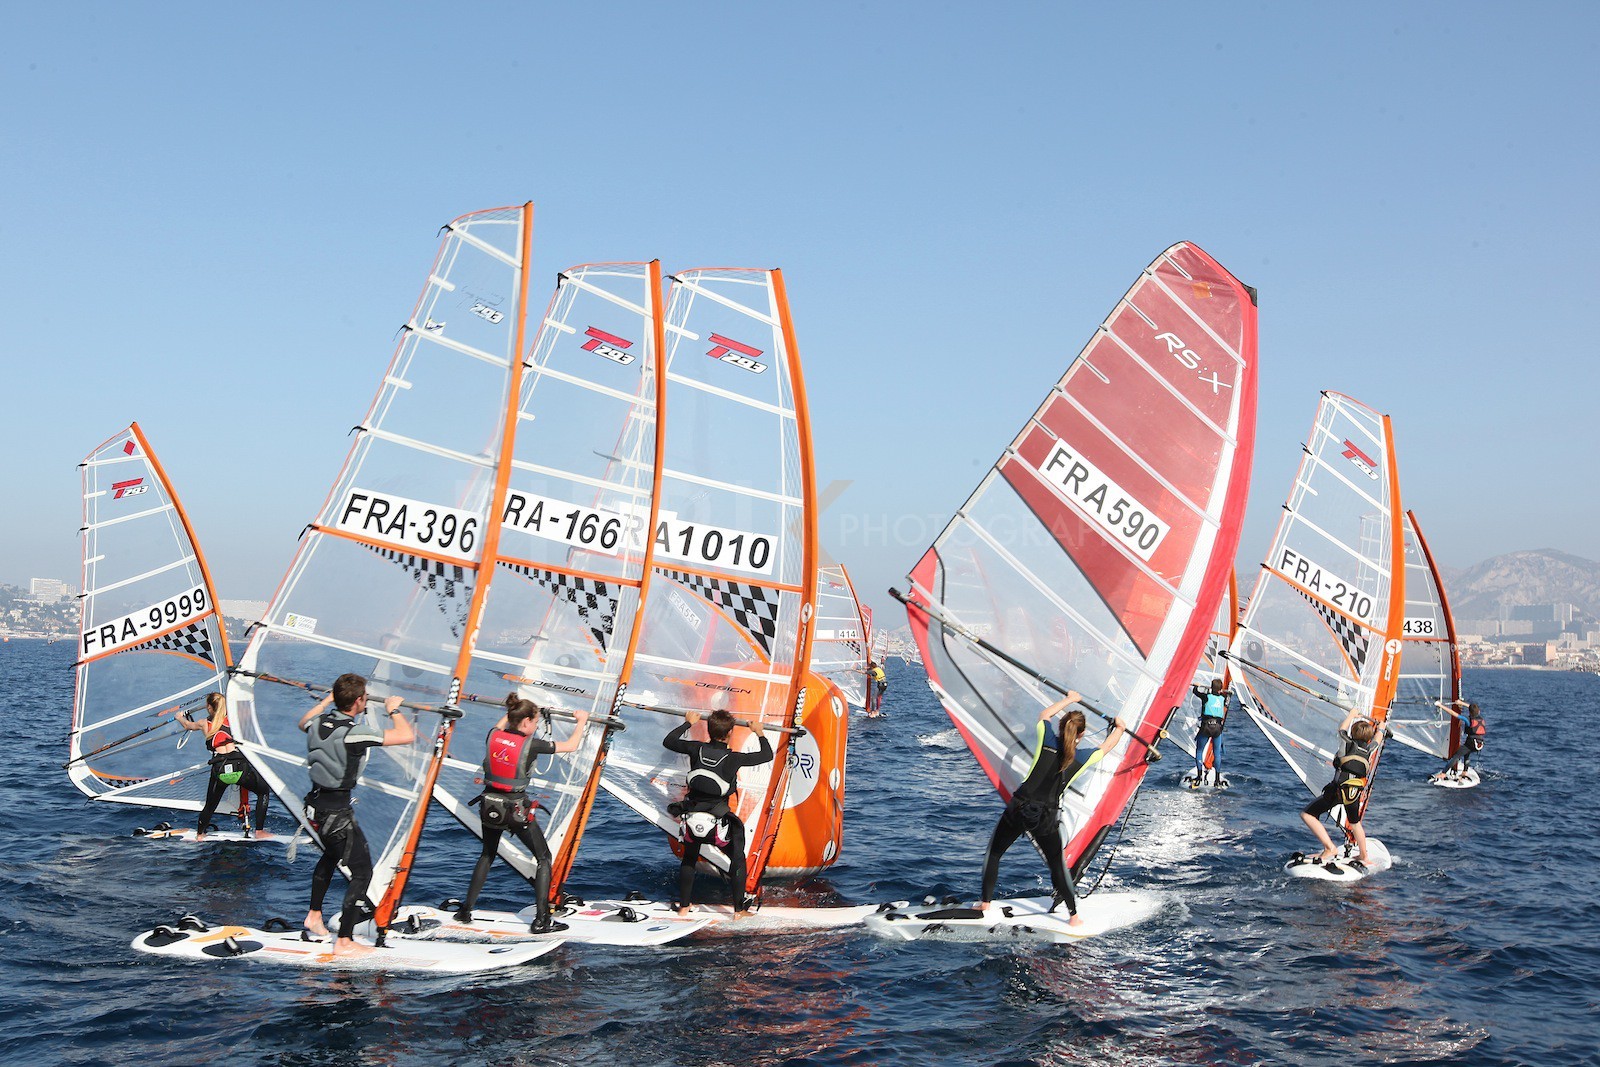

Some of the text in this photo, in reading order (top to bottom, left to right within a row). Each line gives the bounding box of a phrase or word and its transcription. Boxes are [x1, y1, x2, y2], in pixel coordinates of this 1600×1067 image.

[341, 493, 477, 553] FRA-396
[501, 494, 621, 549] RA-166
[1046, 447, 1159, 550] FRA590
[604, 508, 770, 569] RA1010
[1280, 549, 1371, 619] FRA-210
[83, 588, 205, 654] FRA-9999
[1403, 620, 1433, 634] 438
[695, 681, 752, 695] DESIGN
